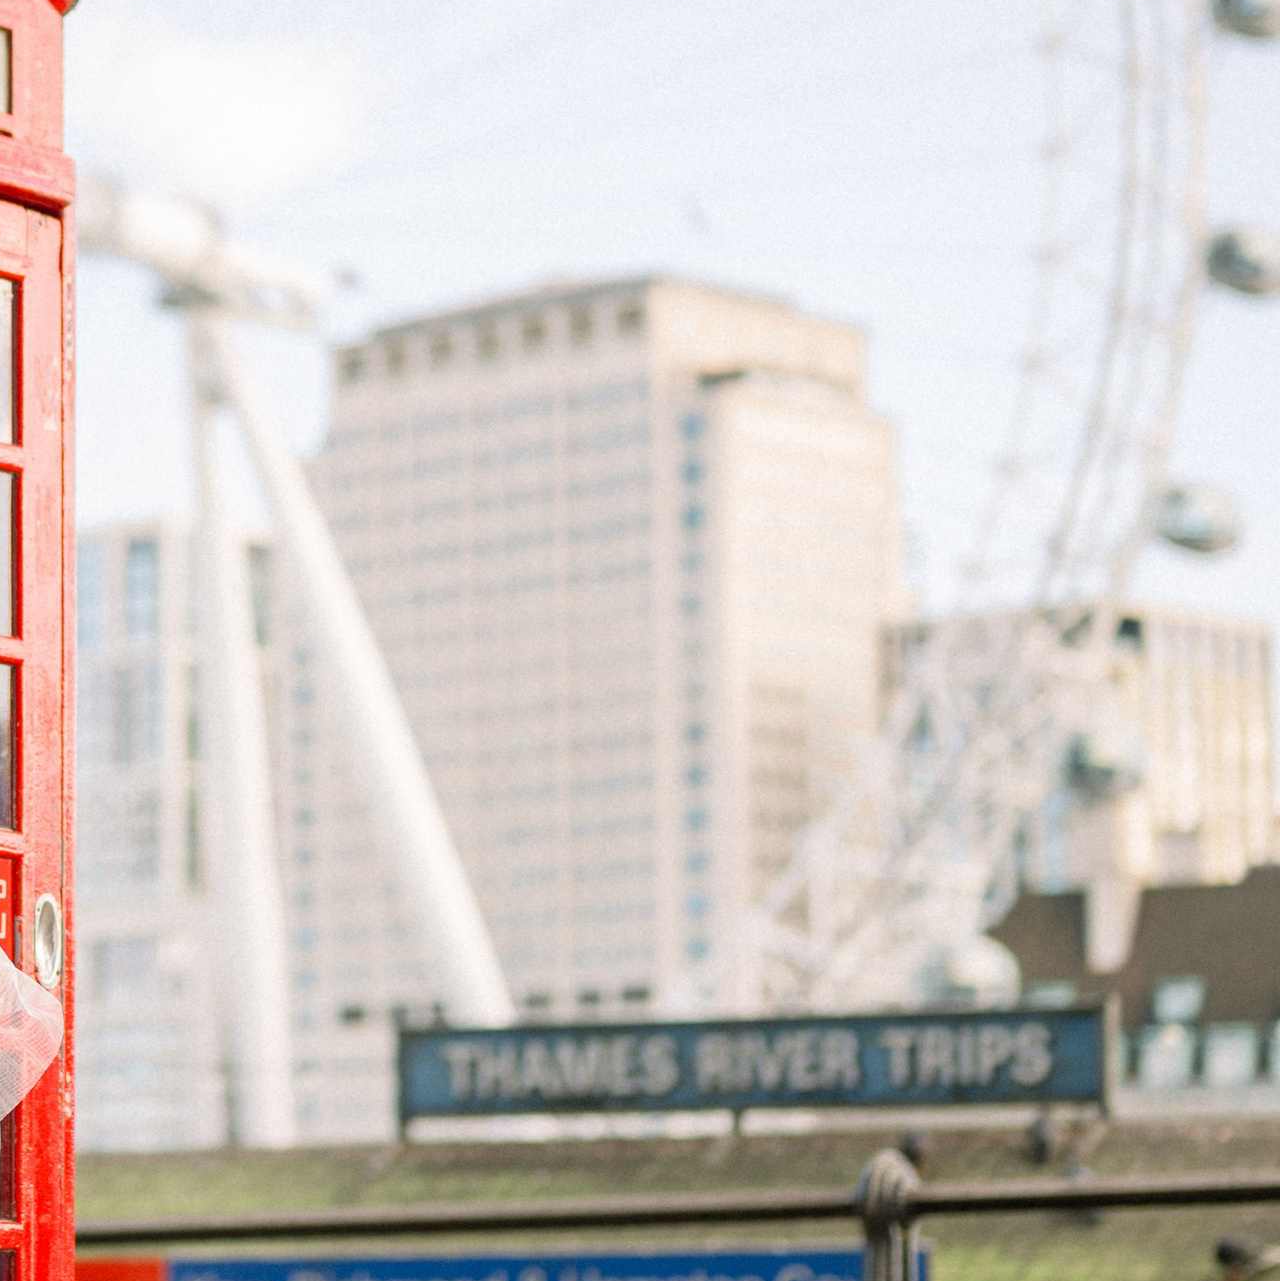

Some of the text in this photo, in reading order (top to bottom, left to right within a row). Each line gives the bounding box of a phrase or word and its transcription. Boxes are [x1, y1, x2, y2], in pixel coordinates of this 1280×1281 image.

[441, 1022, 1053, 1100] THAMES RIVER TRIPS
